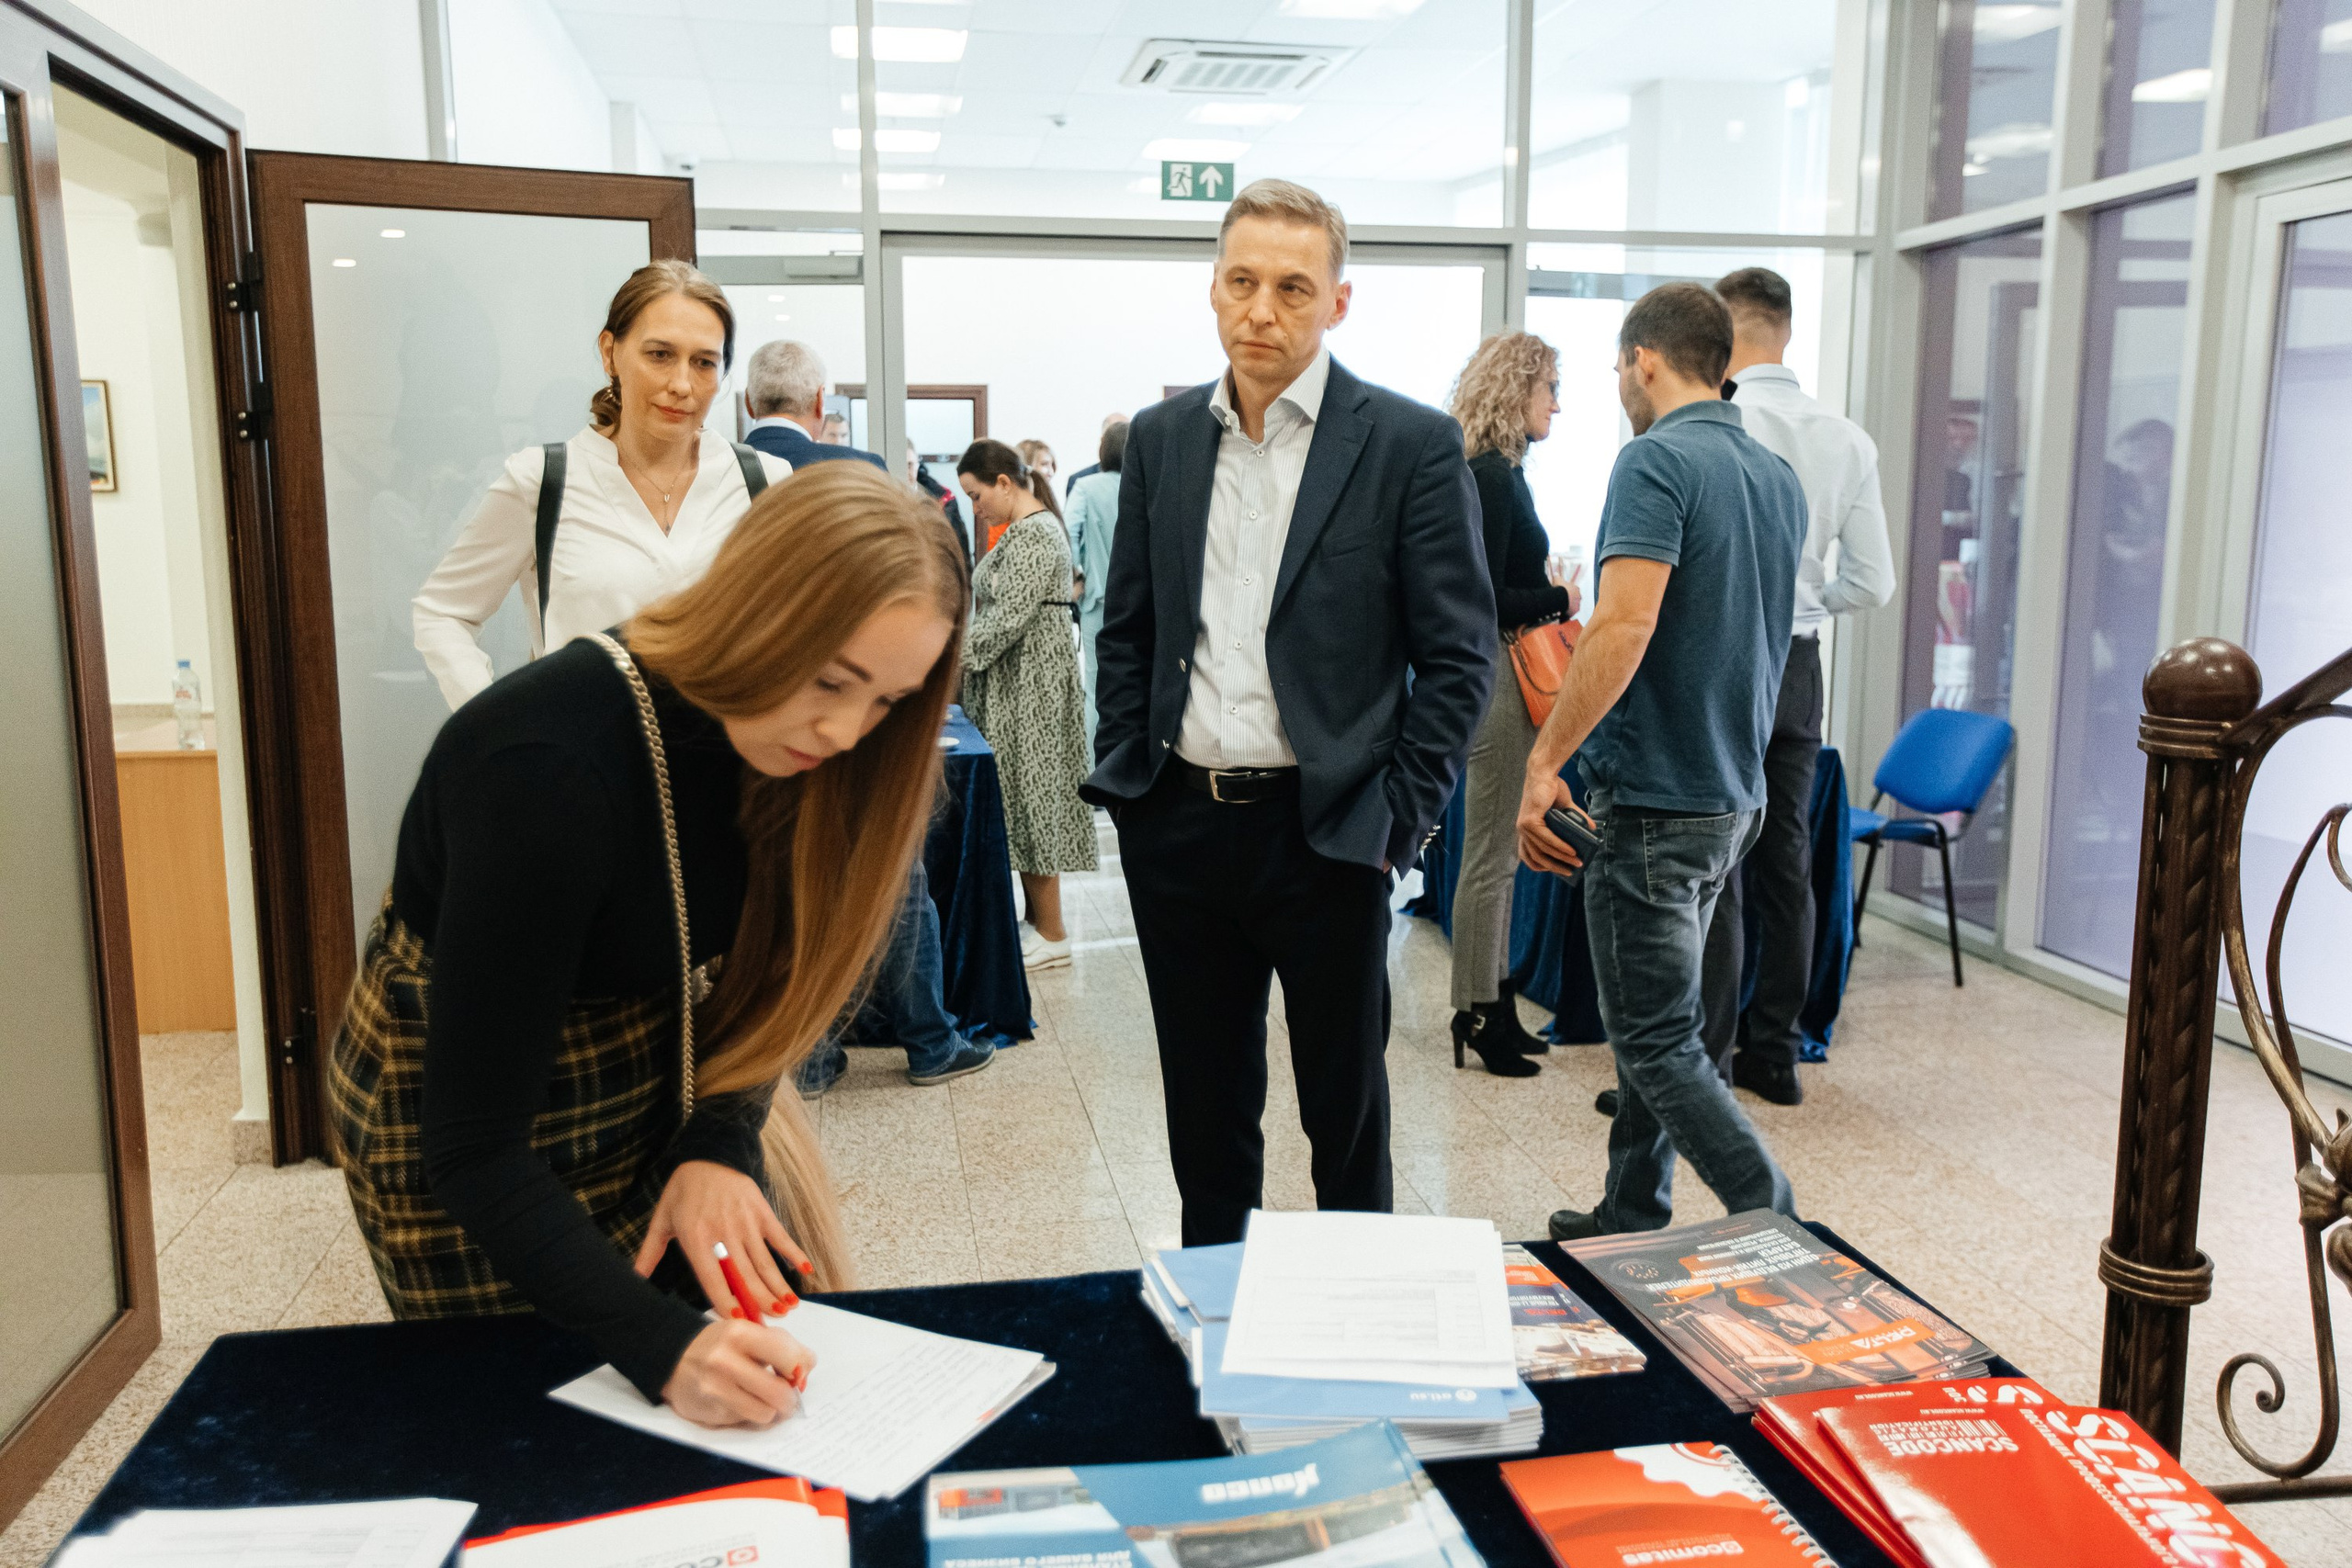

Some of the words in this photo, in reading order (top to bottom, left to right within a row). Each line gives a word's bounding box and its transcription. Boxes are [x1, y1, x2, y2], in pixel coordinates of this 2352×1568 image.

[1758, 1241, 1801, 1258] БАТАРЕЙ
[1765, 1247, 1811, 1264] ТЯГОВЫХ
[1690, 1258, 1767, 1278] ЛИТИЙ-ИОННЫХ
[1776, 1260, 1793, 1271] ИЗ
[1790, 1253, 1819, 1267] ОДИН
[1729, 1263, 1780, 1280] ВЕДУЩИХ
[1645, 1273, 1733, 1292] ПРОИЗВОДИТЕЛЕЙ
[1849, 1325, 1917, 1349] DELTA
[1869, 1419, 1954, 1430] IDENTIFICATION
[1873, 1424, 1957, 1436] AUTOMATIC
[1883, 1436, 2019, 1458] SCANCODE
[1622, 1543, 1724, 1566] comitas
